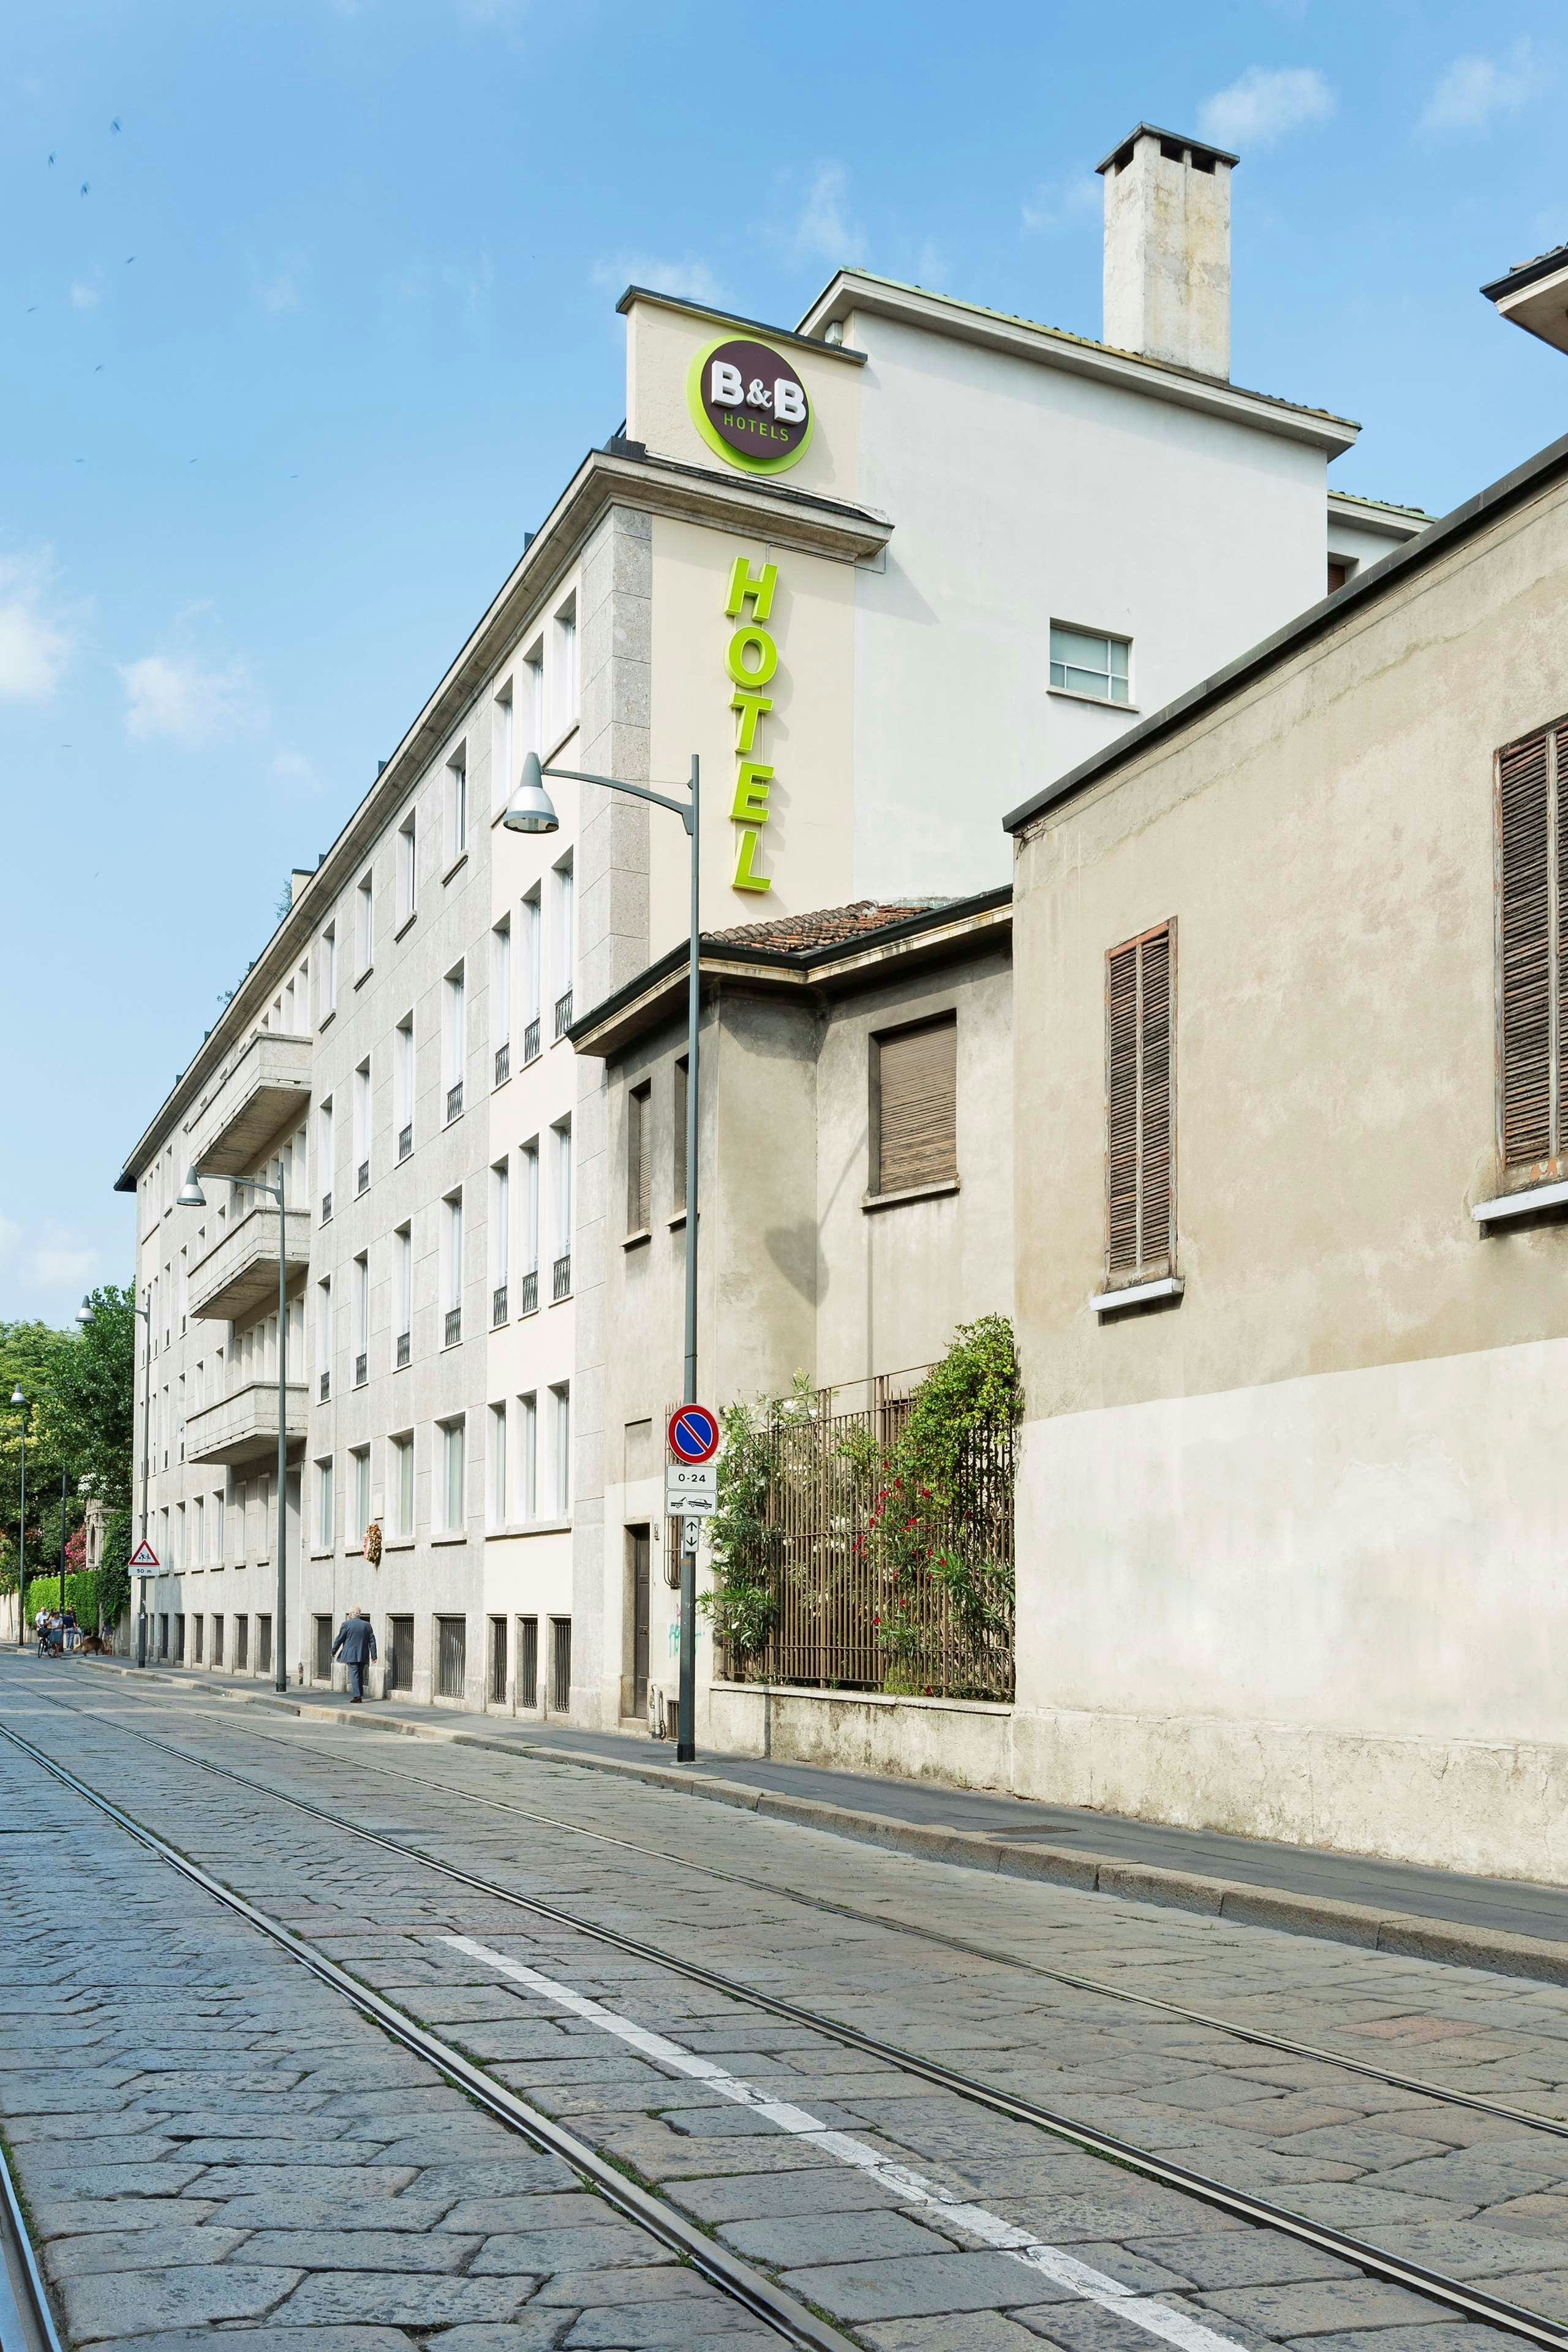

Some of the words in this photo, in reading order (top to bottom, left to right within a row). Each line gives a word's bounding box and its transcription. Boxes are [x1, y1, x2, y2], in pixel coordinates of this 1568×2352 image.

[711, 360, 806, 424] B&B
[723, 412, 789, 442] HOTELS
[725, 556, 778, 891] HOTEL
